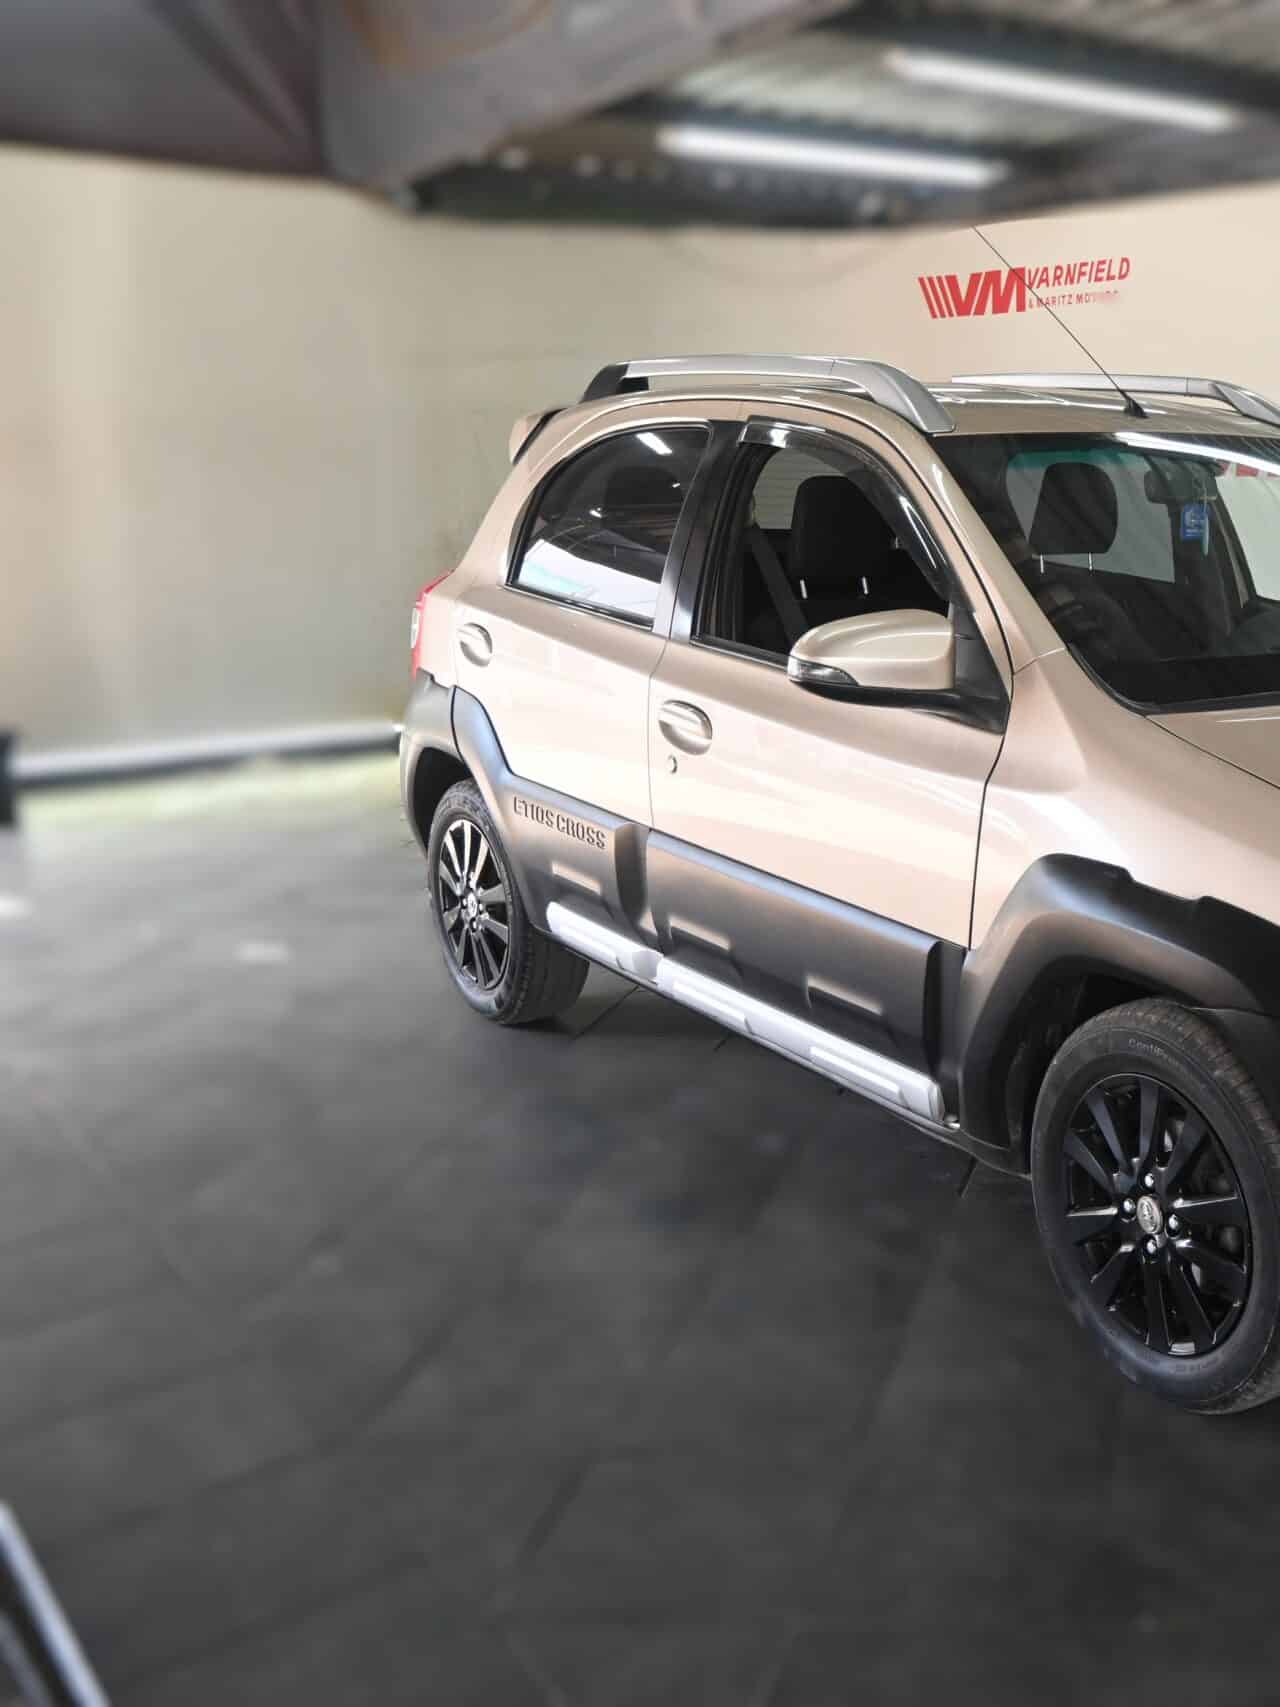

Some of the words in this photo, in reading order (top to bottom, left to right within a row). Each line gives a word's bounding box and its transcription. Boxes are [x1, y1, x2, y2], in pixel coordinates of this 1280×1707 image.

[944, 267, 1026, 317] VM
[1027, 256, 1131, 289] VARNFIELD
[513, 796, 555, 828] ETIOS
[556, 814, 607, 850] CROSS
